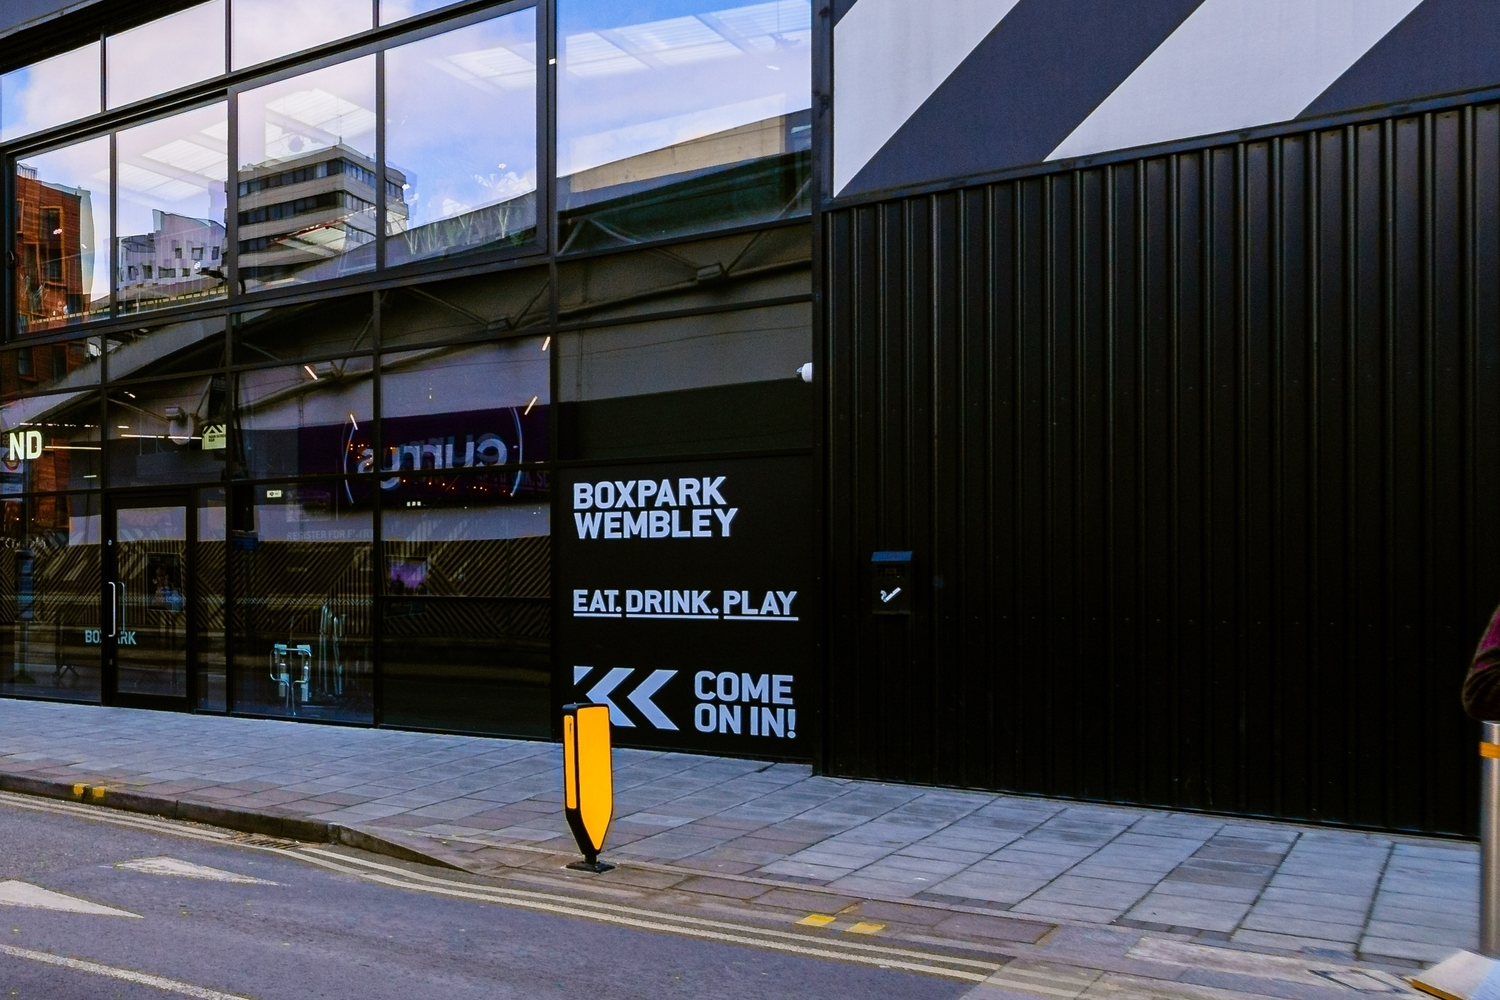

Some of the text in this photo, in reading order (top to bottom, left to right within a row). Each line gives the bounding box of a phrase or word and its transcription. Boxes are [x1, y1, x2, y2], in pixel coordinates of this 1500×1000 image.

[9, 430, 42, 461] ND
[573, 476, 727, 510] BOXPARK
[573, 507, 738, 540] WEMBLEY
[573, 589, 622, 612] EAT.
[625, 589, 719, 615] DRINK.
[694, 670, 793, 705] COME
[694, 704, 797, 739] ON IN!
